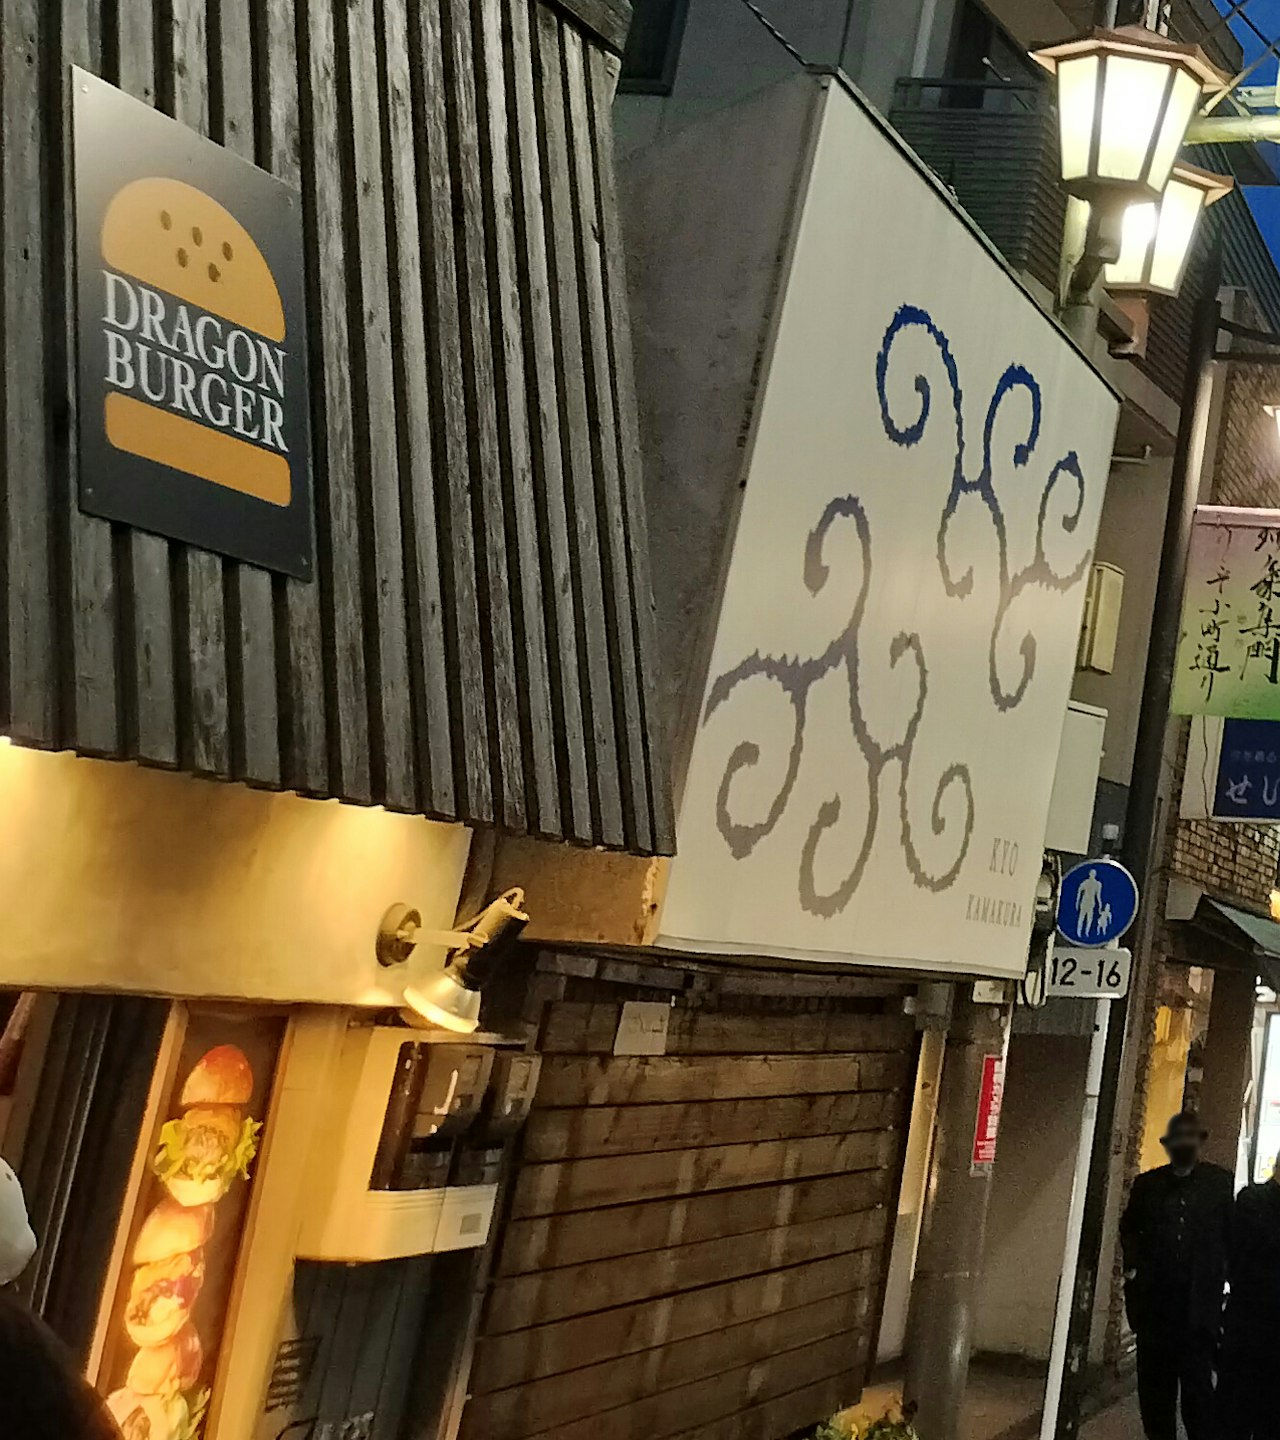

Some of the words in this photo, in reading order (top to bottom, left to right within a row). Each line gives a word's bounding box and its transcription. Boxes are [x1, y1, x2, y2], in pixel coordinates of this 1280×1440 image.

[102, 269, 287, 399] DRAGON
[103, 329, 289, 453] BURGER
[1052, 957, 1121, 988] 12-16
